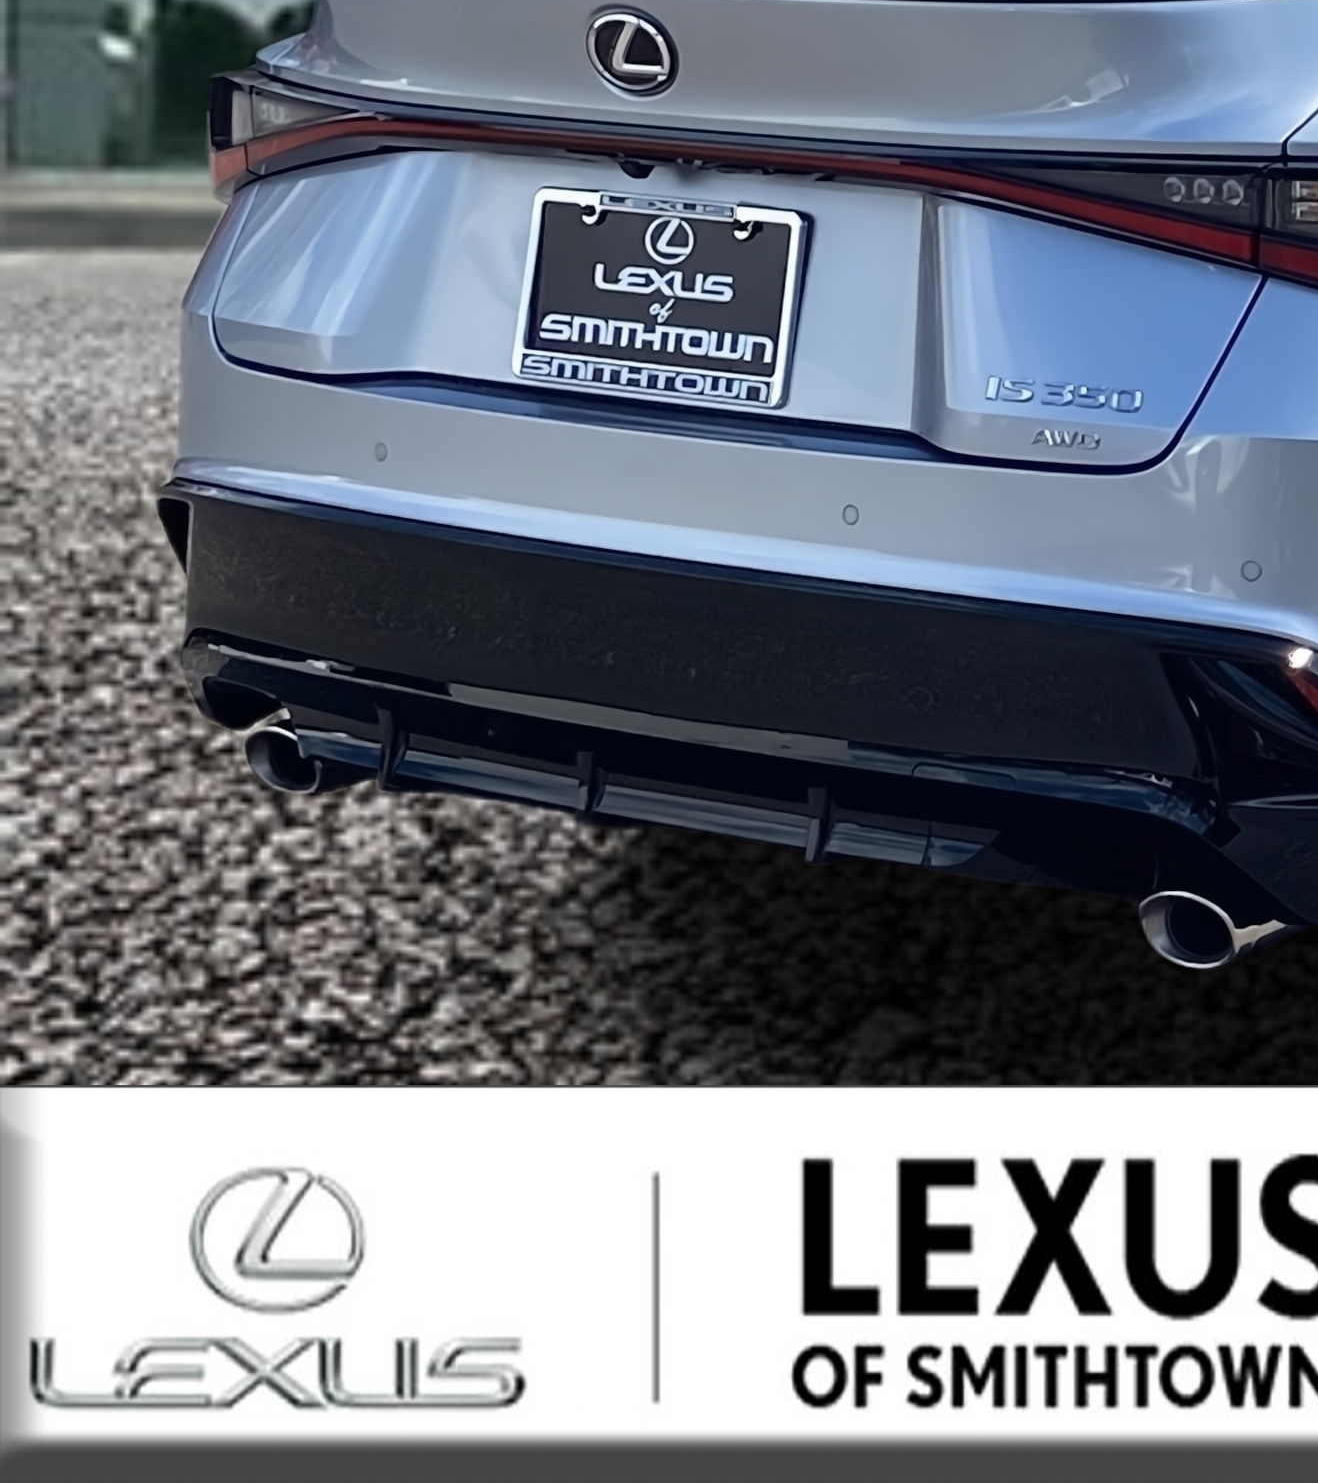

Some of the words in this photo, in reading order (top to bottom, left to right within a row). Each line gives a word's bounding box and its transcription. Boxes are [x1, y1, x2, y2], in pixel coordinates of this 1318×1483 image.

[593, 263, 734, 303] LEXUS
[648, 298, 675, 323] of
[538, 313, 775, 364] SMITHTOWN
[520, 354, 769, 402] SMITHTOWN
[985, 375, 1035, 403] IS
[1041, 382, 1144, 414] 350
[1030, 428, 1101, 451] AWD
